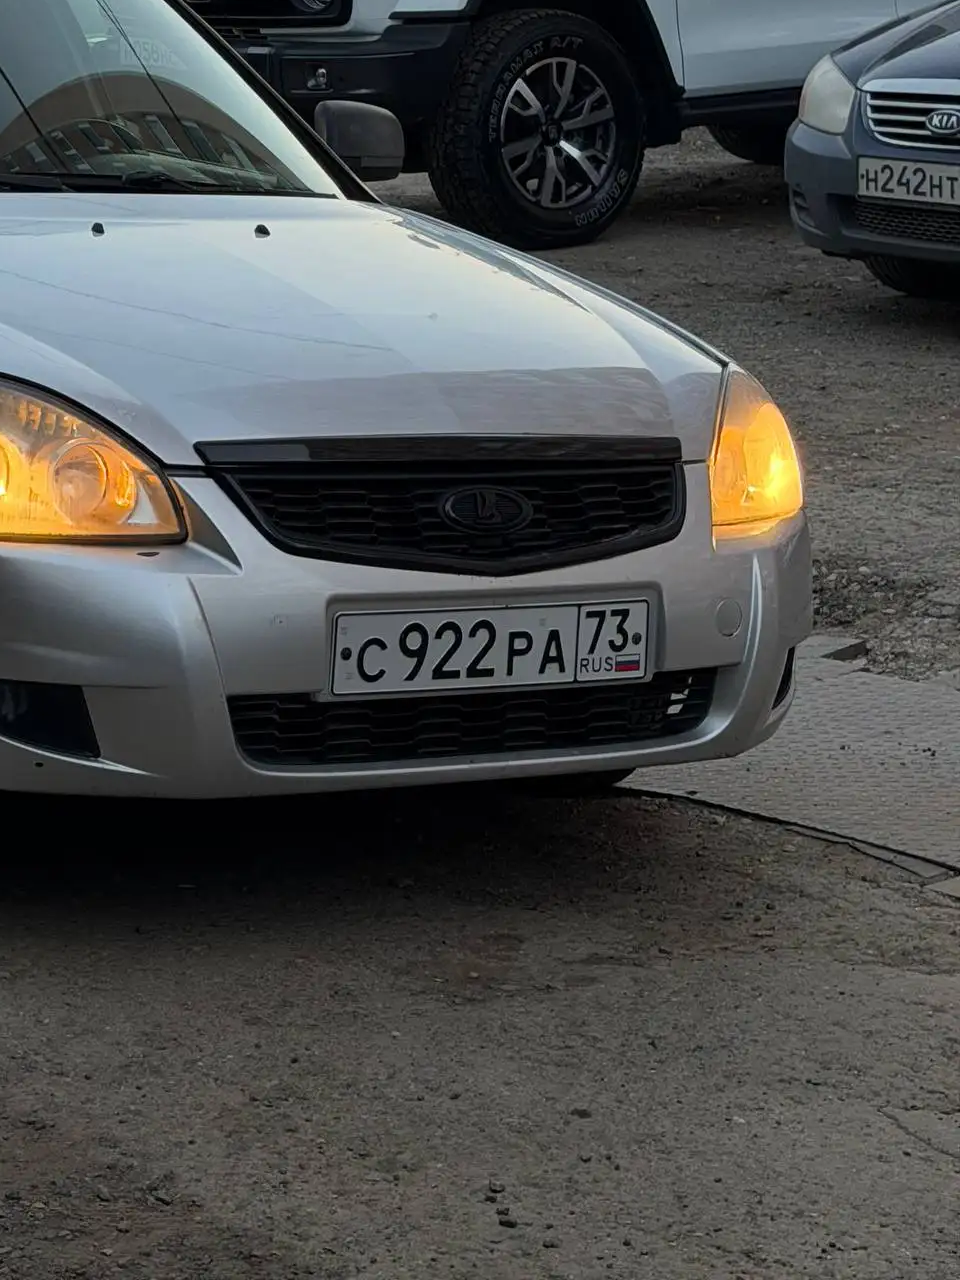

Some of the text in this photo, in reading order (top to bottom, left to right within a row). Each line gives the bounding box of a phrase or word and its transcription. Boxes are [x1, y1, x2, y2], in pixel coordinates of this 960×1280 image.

[932, 114, 958, 128] KIA
[865, 164, 959, 200] Н242НТ
[584, 608, 630, 655] 73
[579, 656, 614, 674] RUS
